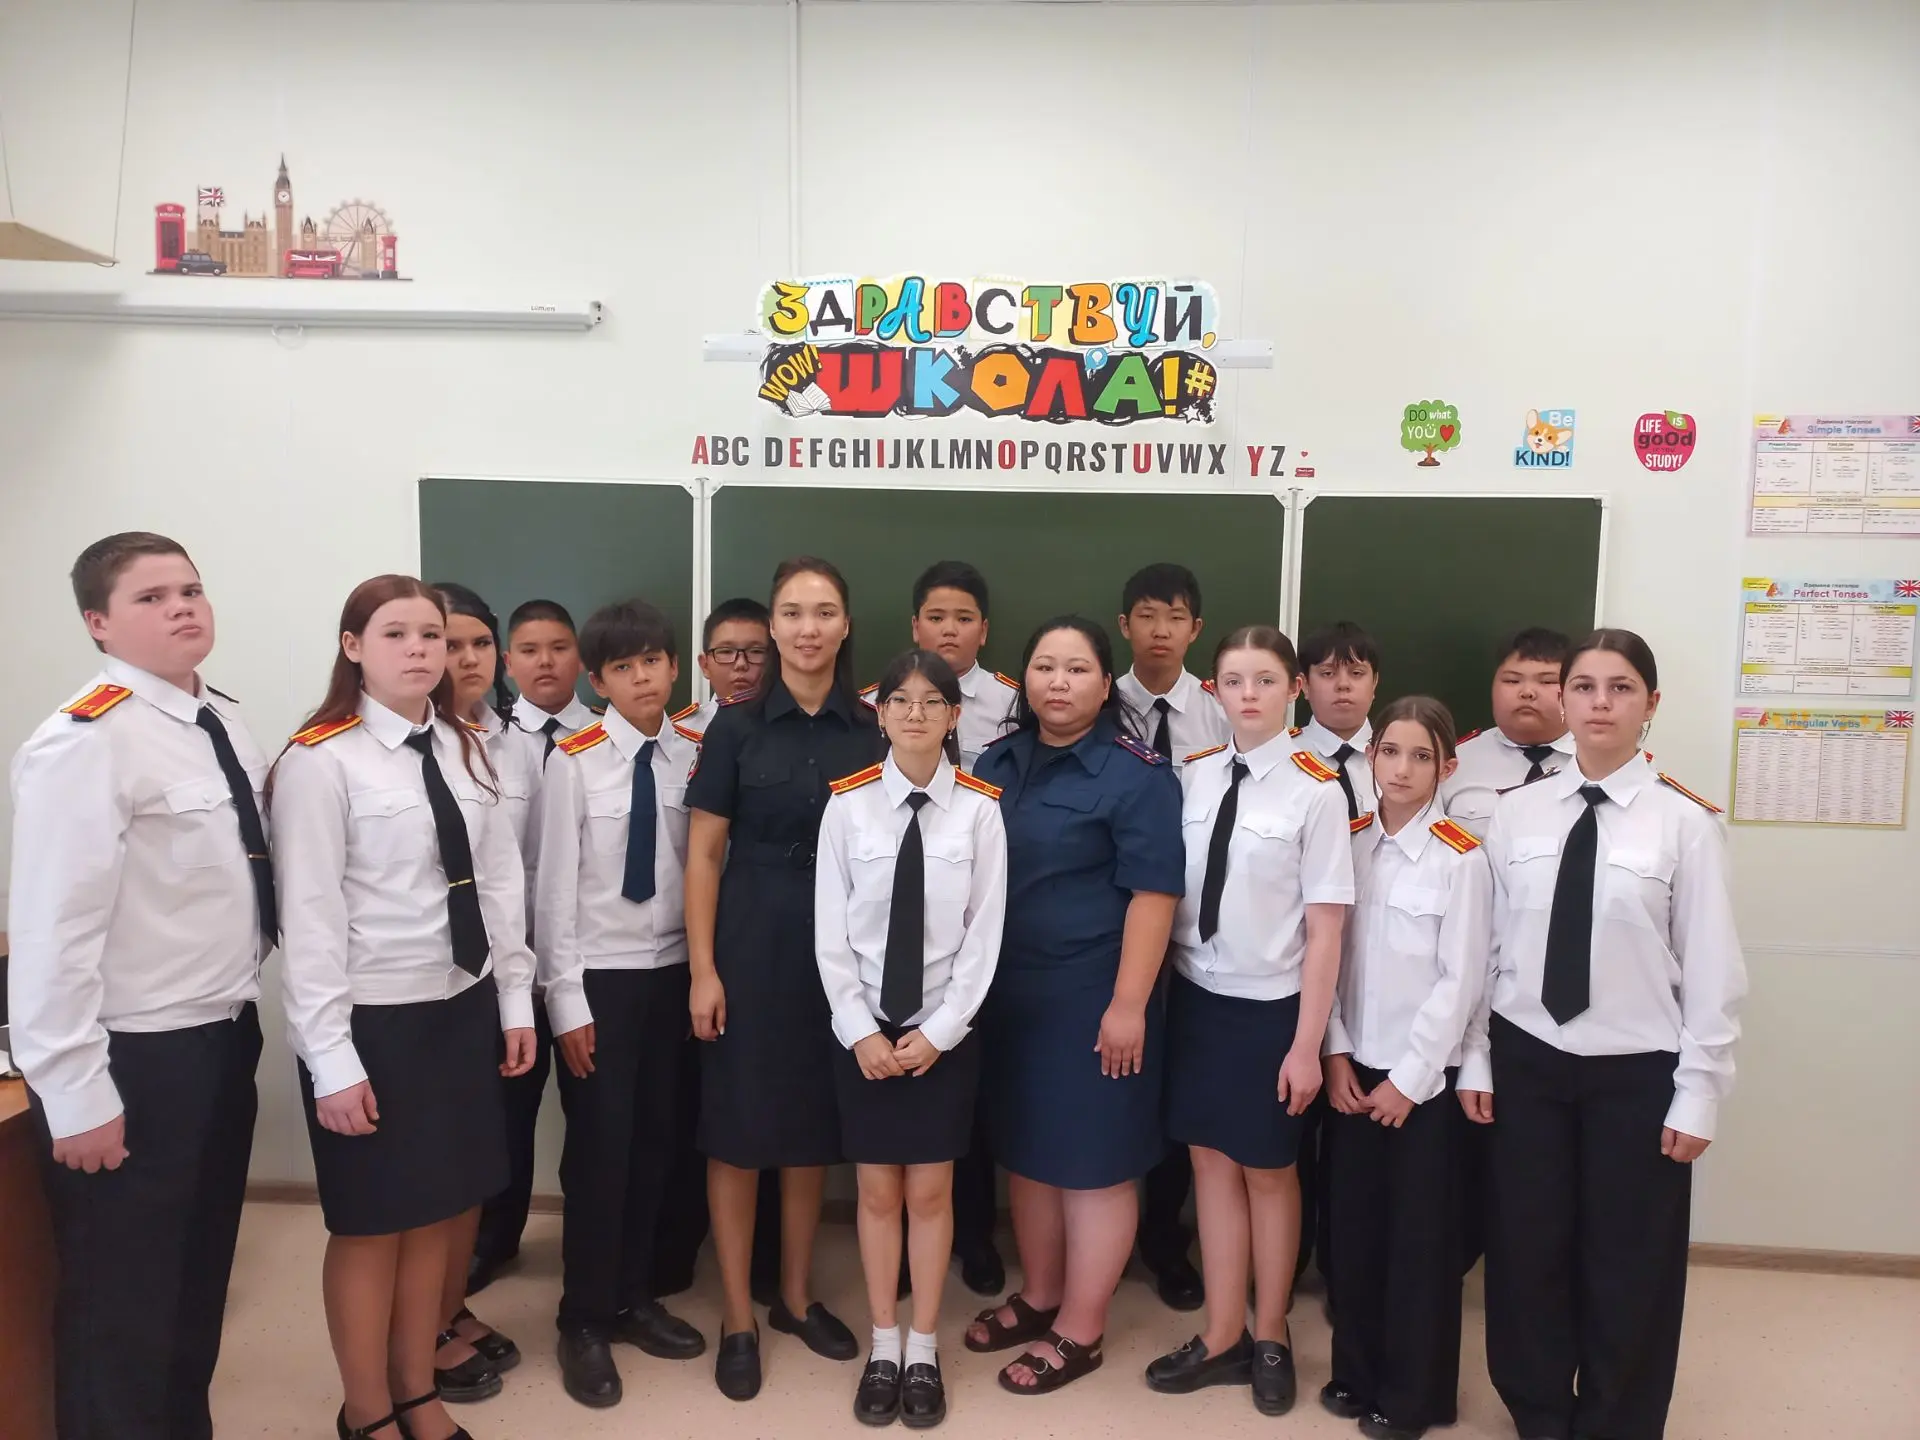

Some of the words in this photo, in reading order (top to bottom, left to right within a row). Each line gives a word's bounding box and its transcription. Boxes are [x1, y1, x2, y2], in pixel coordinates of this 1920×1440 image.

[769, 276, 1217, 350] ЗДРАВСТВУЙ,
[759, 344, 824, 402] WOW!
[814, 347, 1181, 418] ШКОЛА!
[1408, 409, 1428, 422] DO
[1429, 408, 1452, 420] what
[1548, 411, 1574, 427] Be
[1639, 419, 1662, 433] LIFE
[1806, 424, 1842, 436] Simple
[690, 435, 750, 467] ABC
[1246, 445, 1286, 477] YZ
[1515, 449, 1570, 467] KIND!
[1645, 453, 1683, 468] STUDY!
[1793, 588, 1830, 598] Perfect
[1832, 589, 1869, 599] Tenses
[1785, 718, 1829, 729] Irregular
[1831, 719, 1861, 729] Verbs
